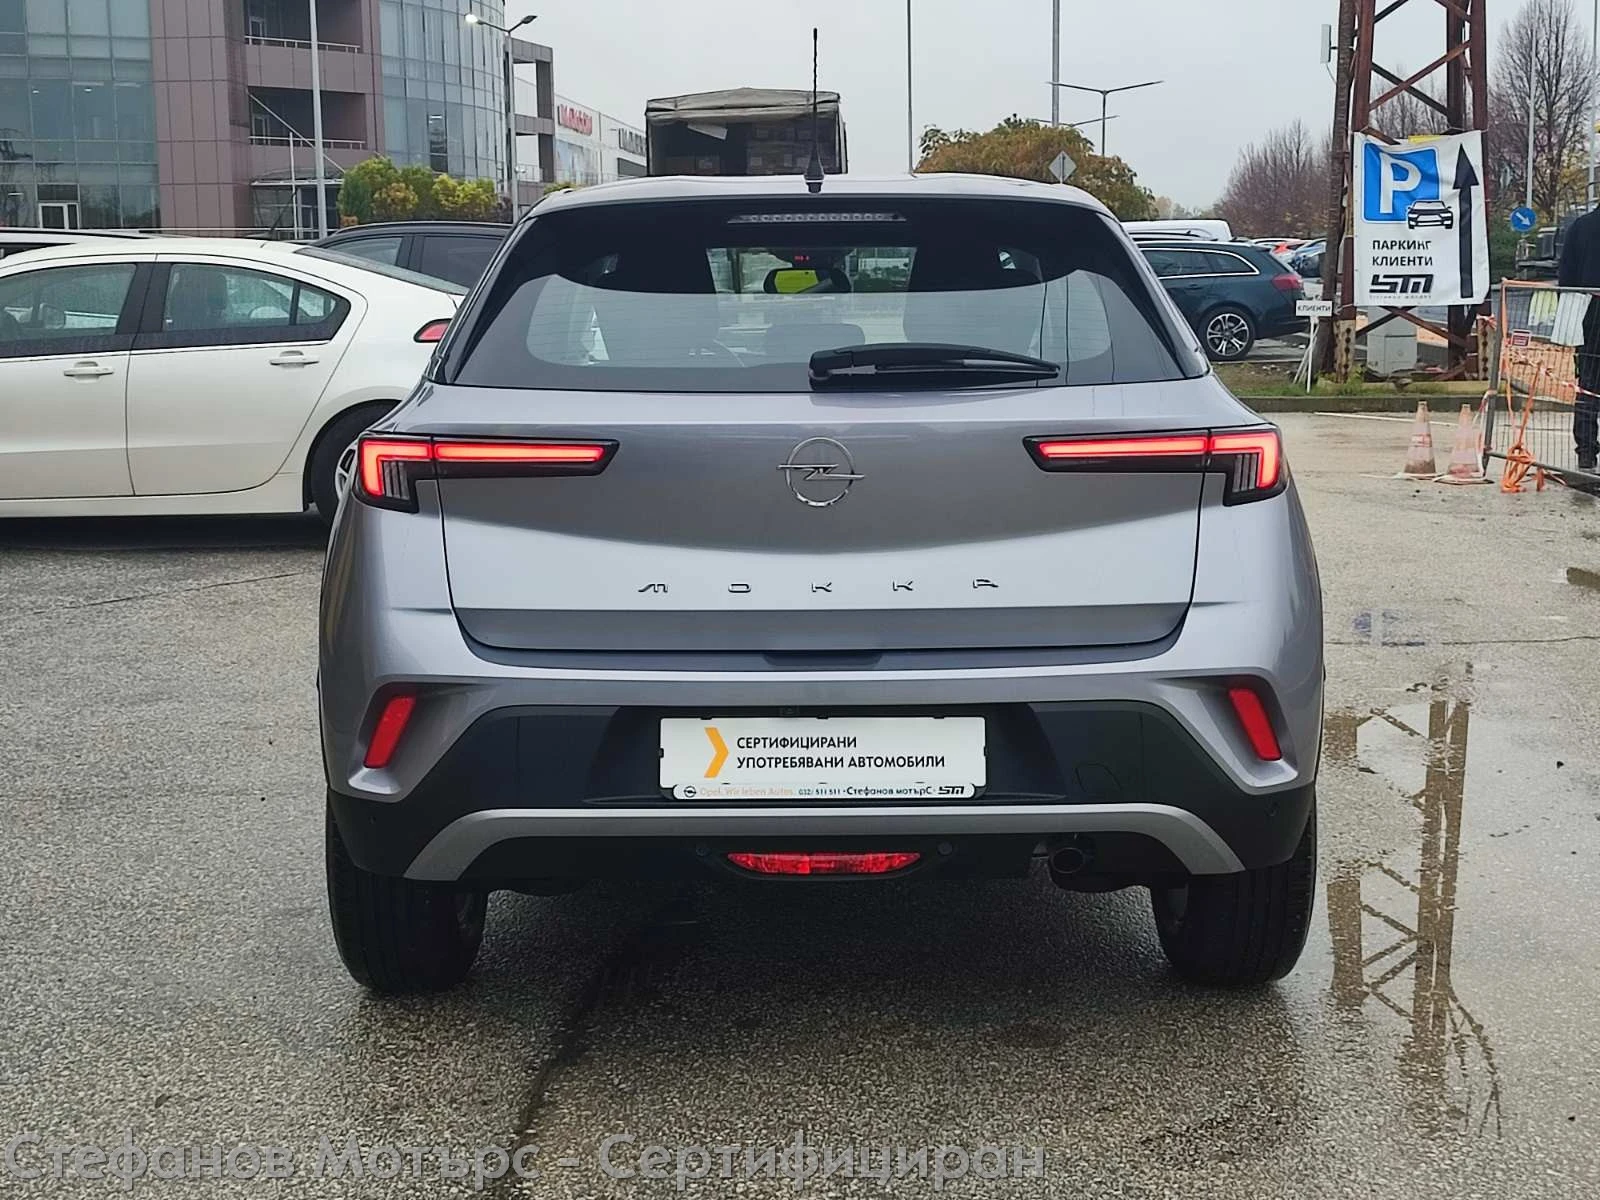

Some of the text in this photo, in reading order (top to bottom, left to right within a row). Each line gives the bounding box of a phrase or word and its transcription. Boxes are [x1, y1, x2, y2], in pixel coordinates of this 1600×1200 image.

[1379, 151, 1422, 214] P
[1372, 239, 1432, 250] ПАРКИНГ
[1372, 256, 1433, 267] КЛИЕНТИ
[638, 578, 1000, 594] MOKKA
[736, 736, 858, 750] СЕРТИФИЦИРАНИ
[736, 755, 946, 769] УПОТРЕБЯВАНИ АВТОМОБИЛИ
